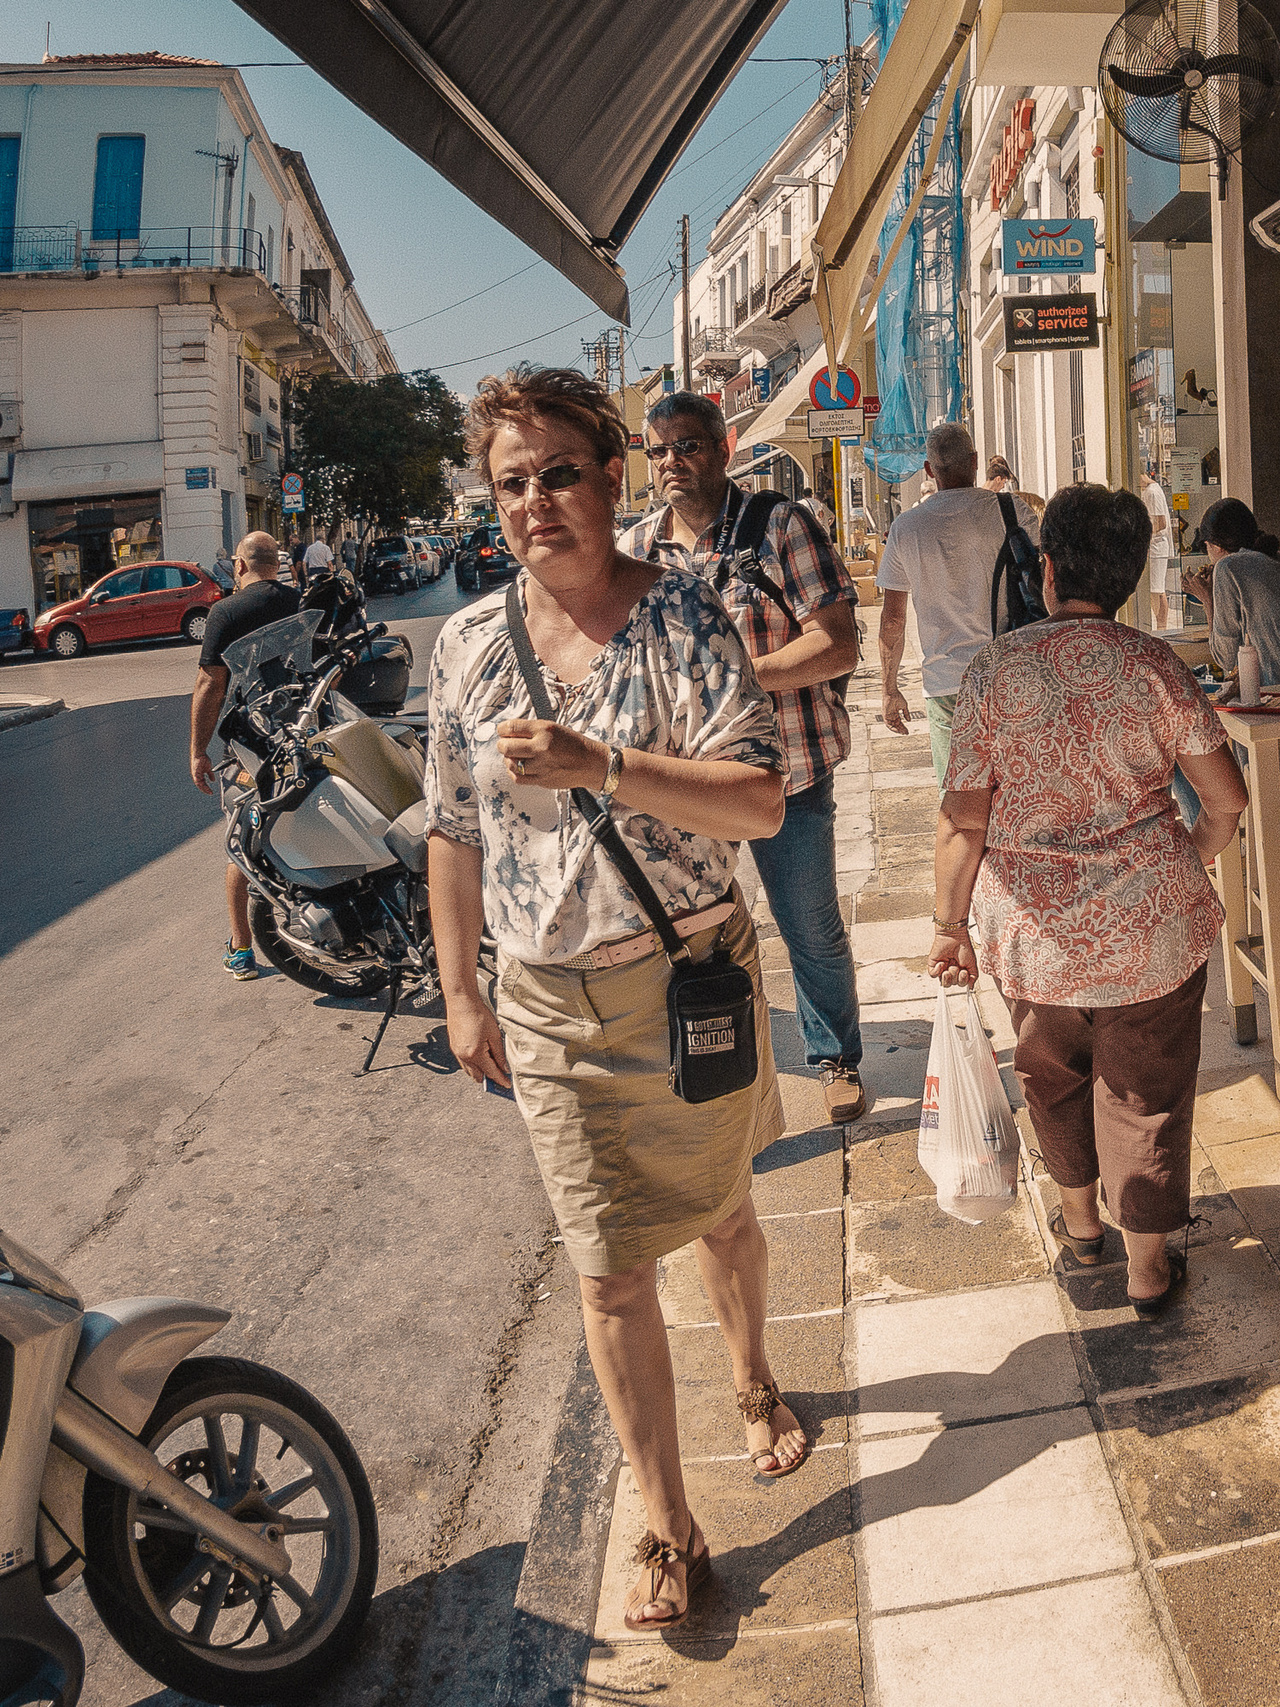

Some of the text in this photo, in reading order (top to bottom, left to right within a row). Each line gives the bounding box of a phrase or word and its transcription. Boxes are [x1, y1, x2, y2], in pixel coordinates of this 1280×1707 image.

[1016, 239, 1084, 257] WIND
[1037, 305, 1088, 317] authorized
[1038, 315, 1088, 330] service
[688, 1028, 735, 1046] IGNITION
